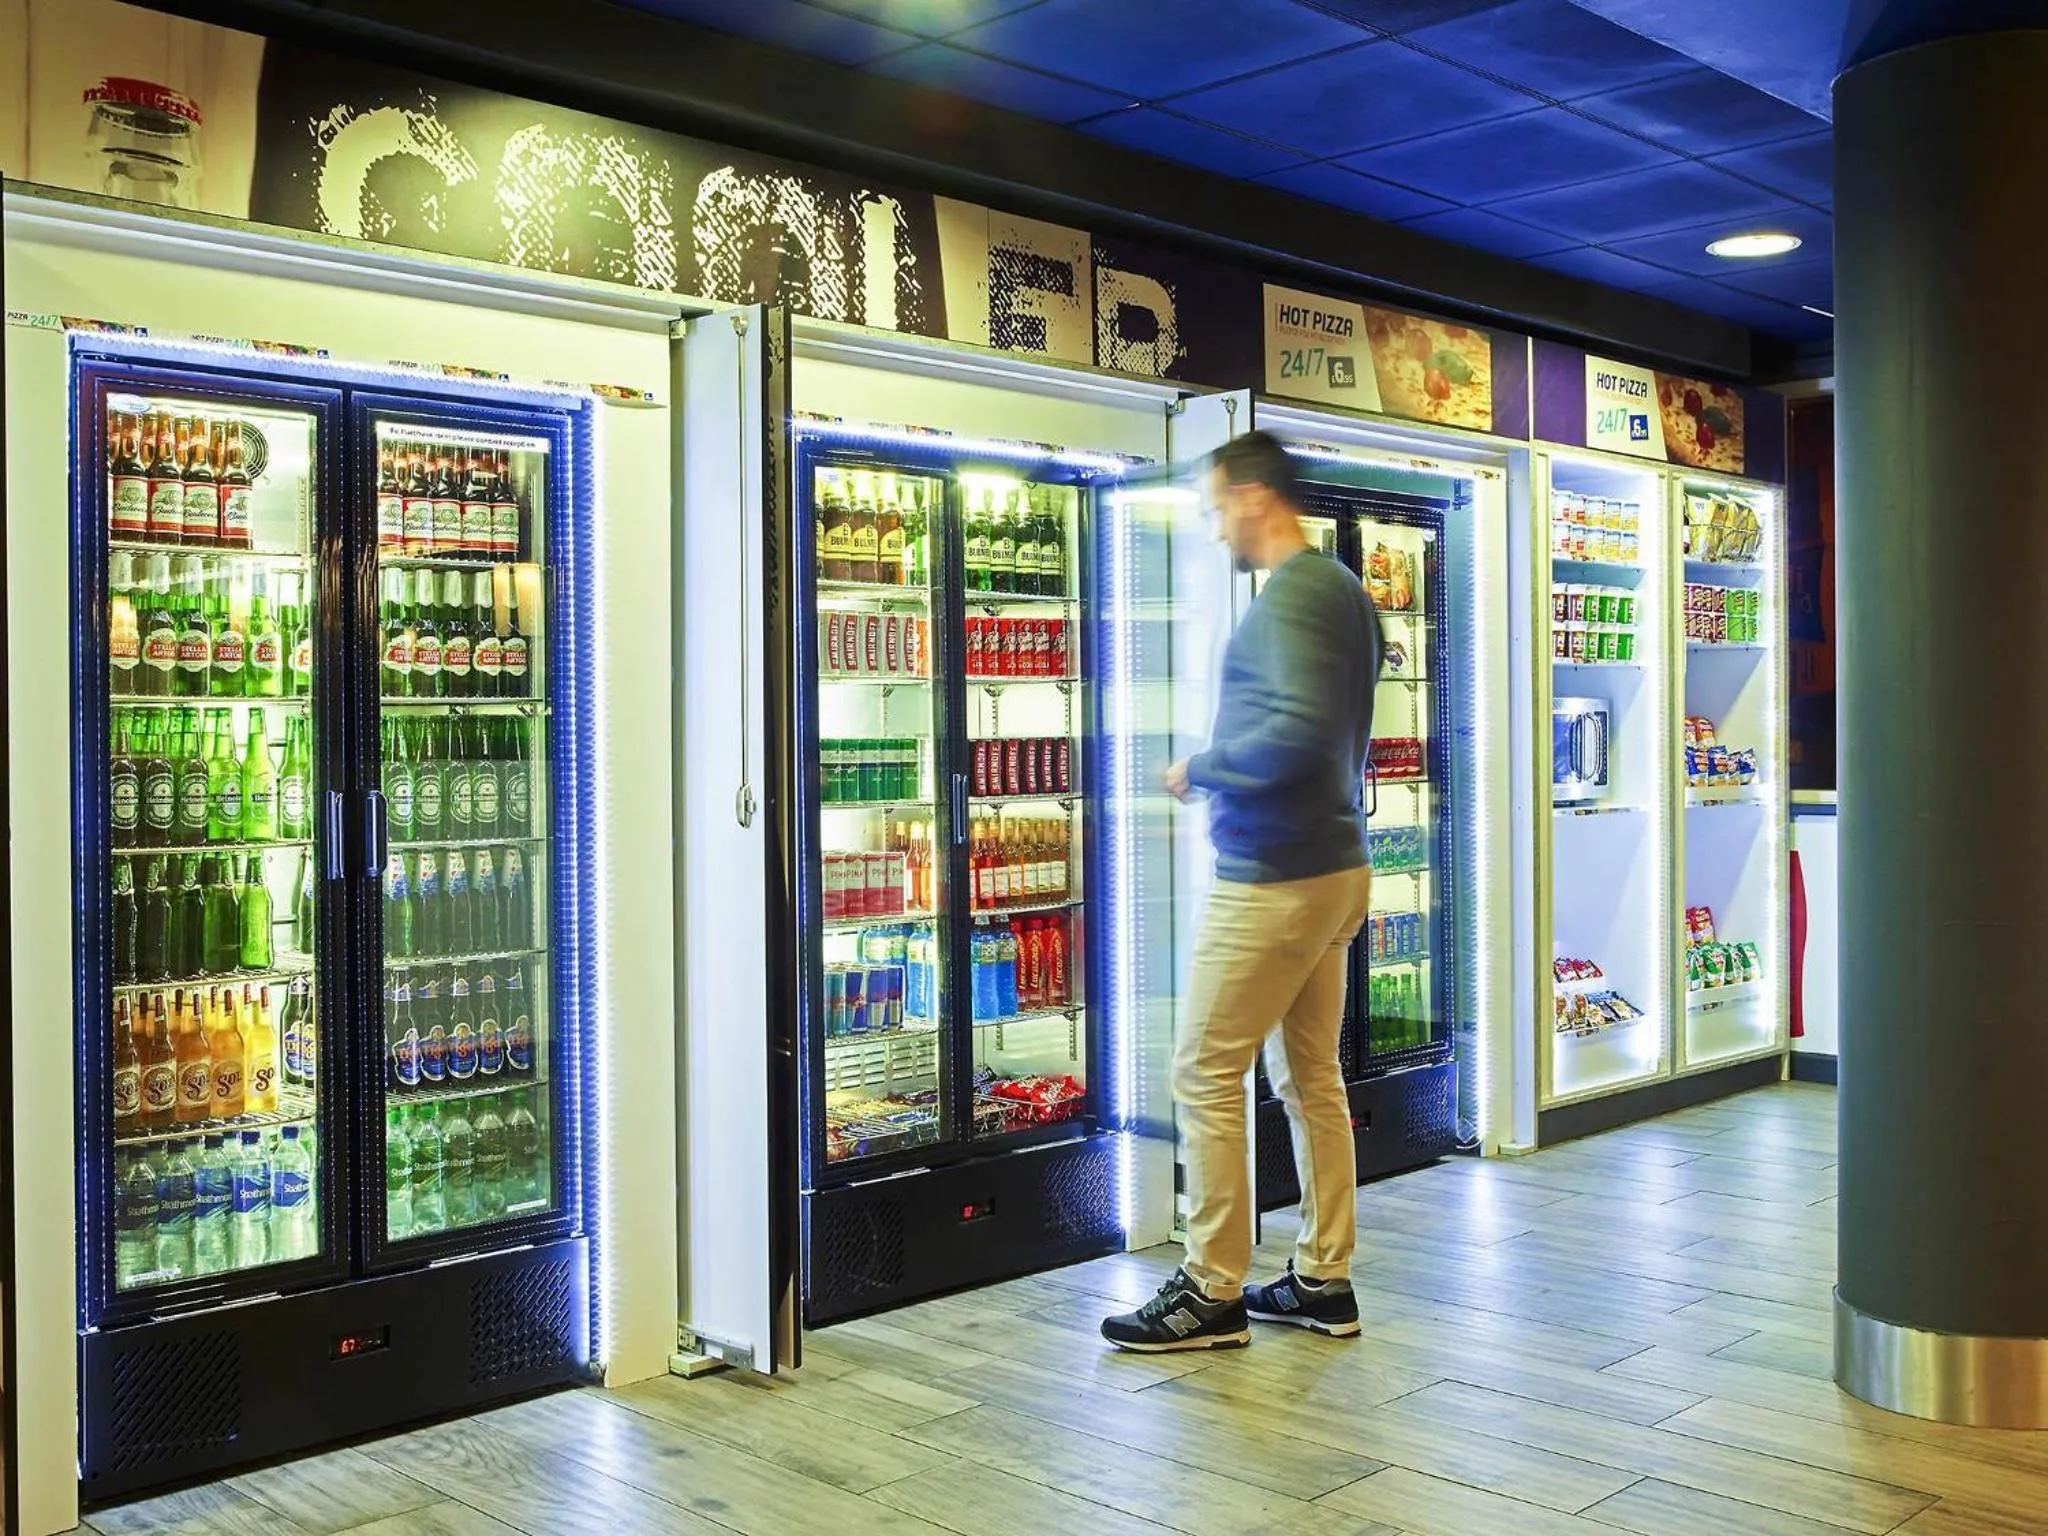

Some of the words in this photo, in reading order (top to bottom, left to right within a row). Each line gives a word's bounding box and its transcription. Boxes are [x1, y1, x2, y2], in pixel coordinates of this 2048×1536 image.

[8, 311, 28, 320] PIZZA
[31, 314, 58, 327] 24/7
[1279, 304, 1310, 328] HOT
[1313, 311, 1353, 337] PIZZA
[1280, 348, 1325, 378] 24/7
[1596, 372, 1617, 390] HOT
[1619, 377, 1648, 398] PIZZA
[1597, 408, 1628, 434] 24/7
[255, 1067, 274, 1092] So
[1162, 1307, 1202, 1339] N
